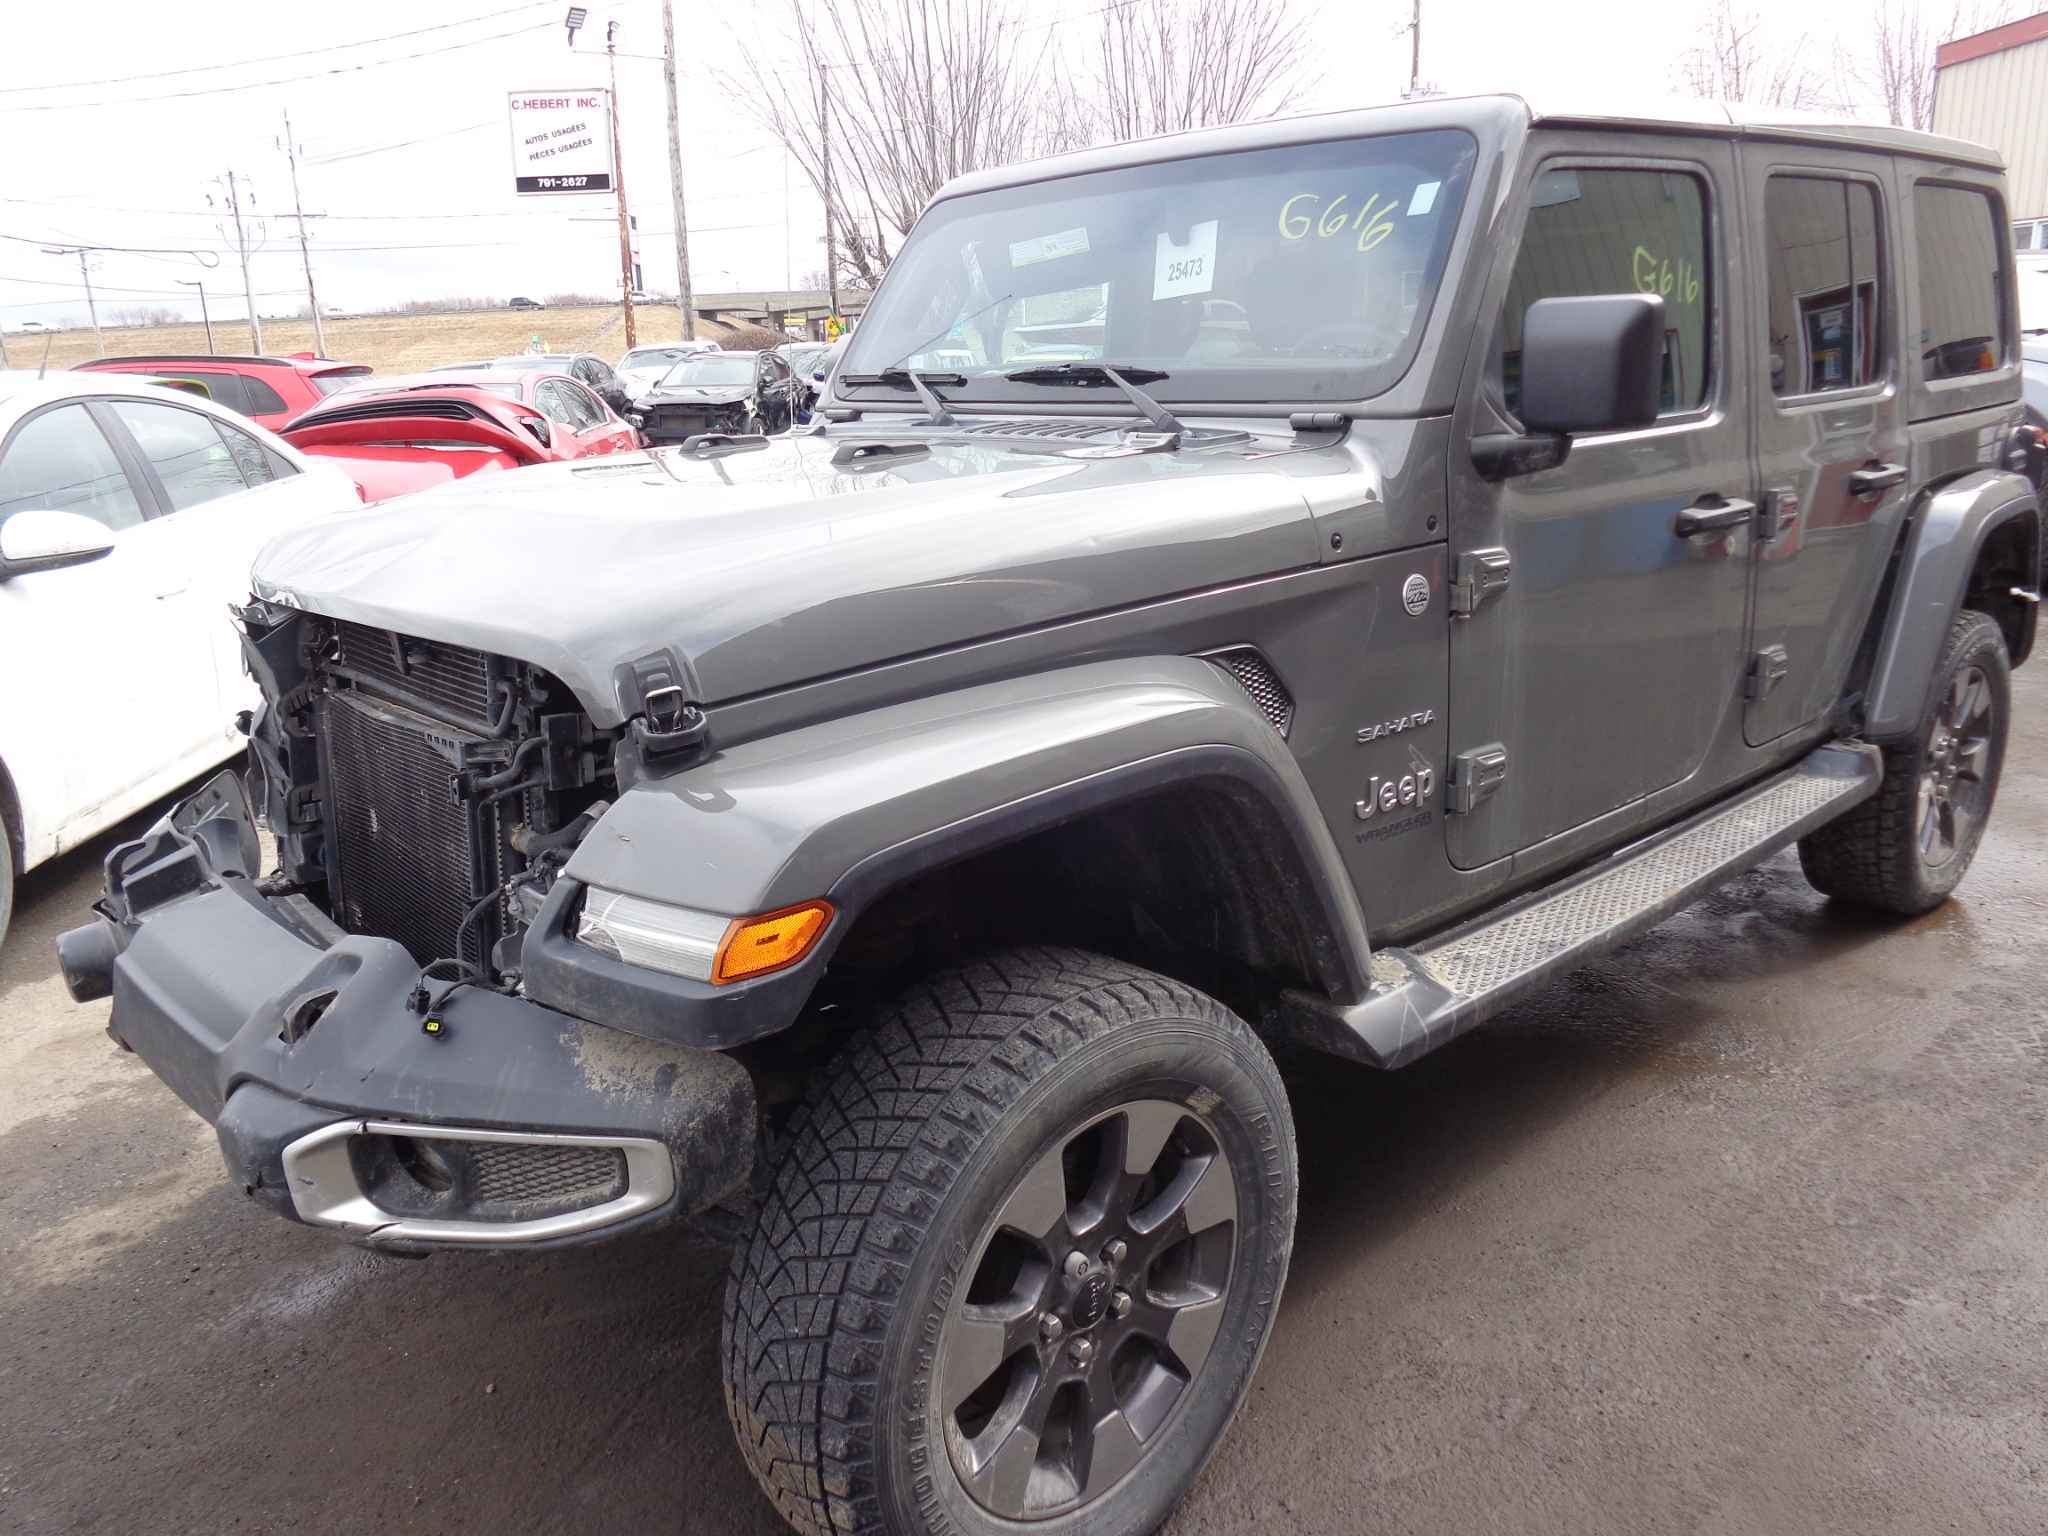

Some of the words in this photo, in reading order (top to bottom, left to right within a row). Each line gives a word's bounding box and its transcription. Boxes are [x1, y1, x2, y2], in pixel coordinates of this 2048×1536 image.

[577, 98, 601, 108] INC.
[525, 133, 548, 144] AUTOS
[1278, 193, 1399, 252] G616
[1167, 257, 1204, 282] 25473
[1632, 245, 1698, 304] G616
[1356, 709, 1435, 744] SAHARA
[1355, 768, 1435, 820] Jeep
